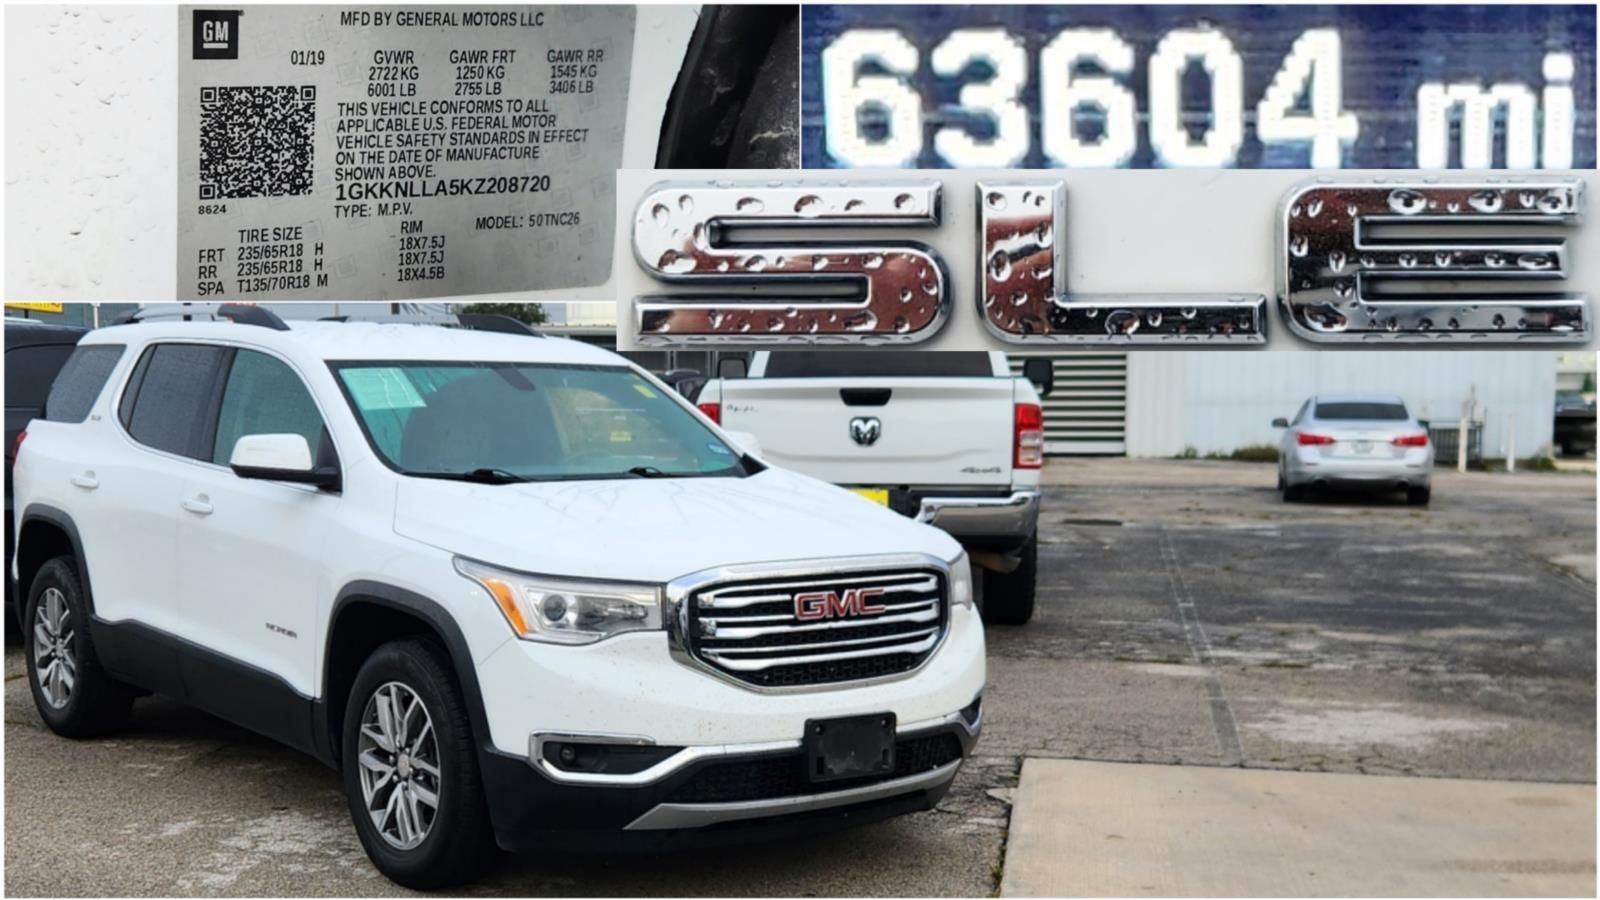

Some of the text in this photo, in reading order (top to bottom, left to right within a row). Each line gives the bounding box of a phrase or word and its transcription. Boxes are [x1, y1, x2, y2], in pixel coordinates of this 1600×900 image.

[341, 11, 544, 26] MFD BY GENERAL MOTORS LLC
[203, 20, 229, 42] GM
[291, 50, 325, 66] 01/19
[374, 50, 414, 65] GVWR
[449, 50, 517, 64] GAWR FRT
[547, 49, 604, 63] GAWR RR
[369, 66, 419, 81] 2722 KG
[456, 65, 505, 80] 1250 KG
[551, 65, 597, 78] 1545 KG
[368, 83, 416, 97] 6001 LB
[455, 82, 502, 96] 2755 LB
[549, 80, 593, 94] 3406 LB
[822, 26, 1576, 169] 63604 mi
[338, 99, 549, 116] THIS VEHICLE CONFORMS TO ALL
[337, 114, 556, 133] APPLICABLE U.S. FEDERAL MOTOR
[336, 129, 589, 149] VEHICLE SAFETY STANDARDS IN EFFECT
[335, 146, 540, 166] ON THE DATE OF MANUFACTURE
[335, 165, 437, 181] SHOWN ABOVE.
[335, 175, 550, 201] 1GKKNLLA5KZ208720
[198, 204, 227, 215] 8624
[334, 203, 413, 218] TYPE: M.P.V.
[401, 221, 423, 235] RIM
[475, 212, 580, 230] MODEL: 50TNC26
[238, 227, 303, 243] TIRE SIZE
[399, 236, 445, 251] 18X7.5J
[199, 242, 324, 263] FRT 235/65R18 H
[398, 251, 444, 266] 18X7.5J
[198, 258, 323, 279] RR 235/65R18 H
[632, 178, 1586, 345] SLE
[397, 266, 445, 282] 18X4.5B
[198, 274, 328, 296] SPA T135/70R18 M
[794, 586, 887, 621] GMC
